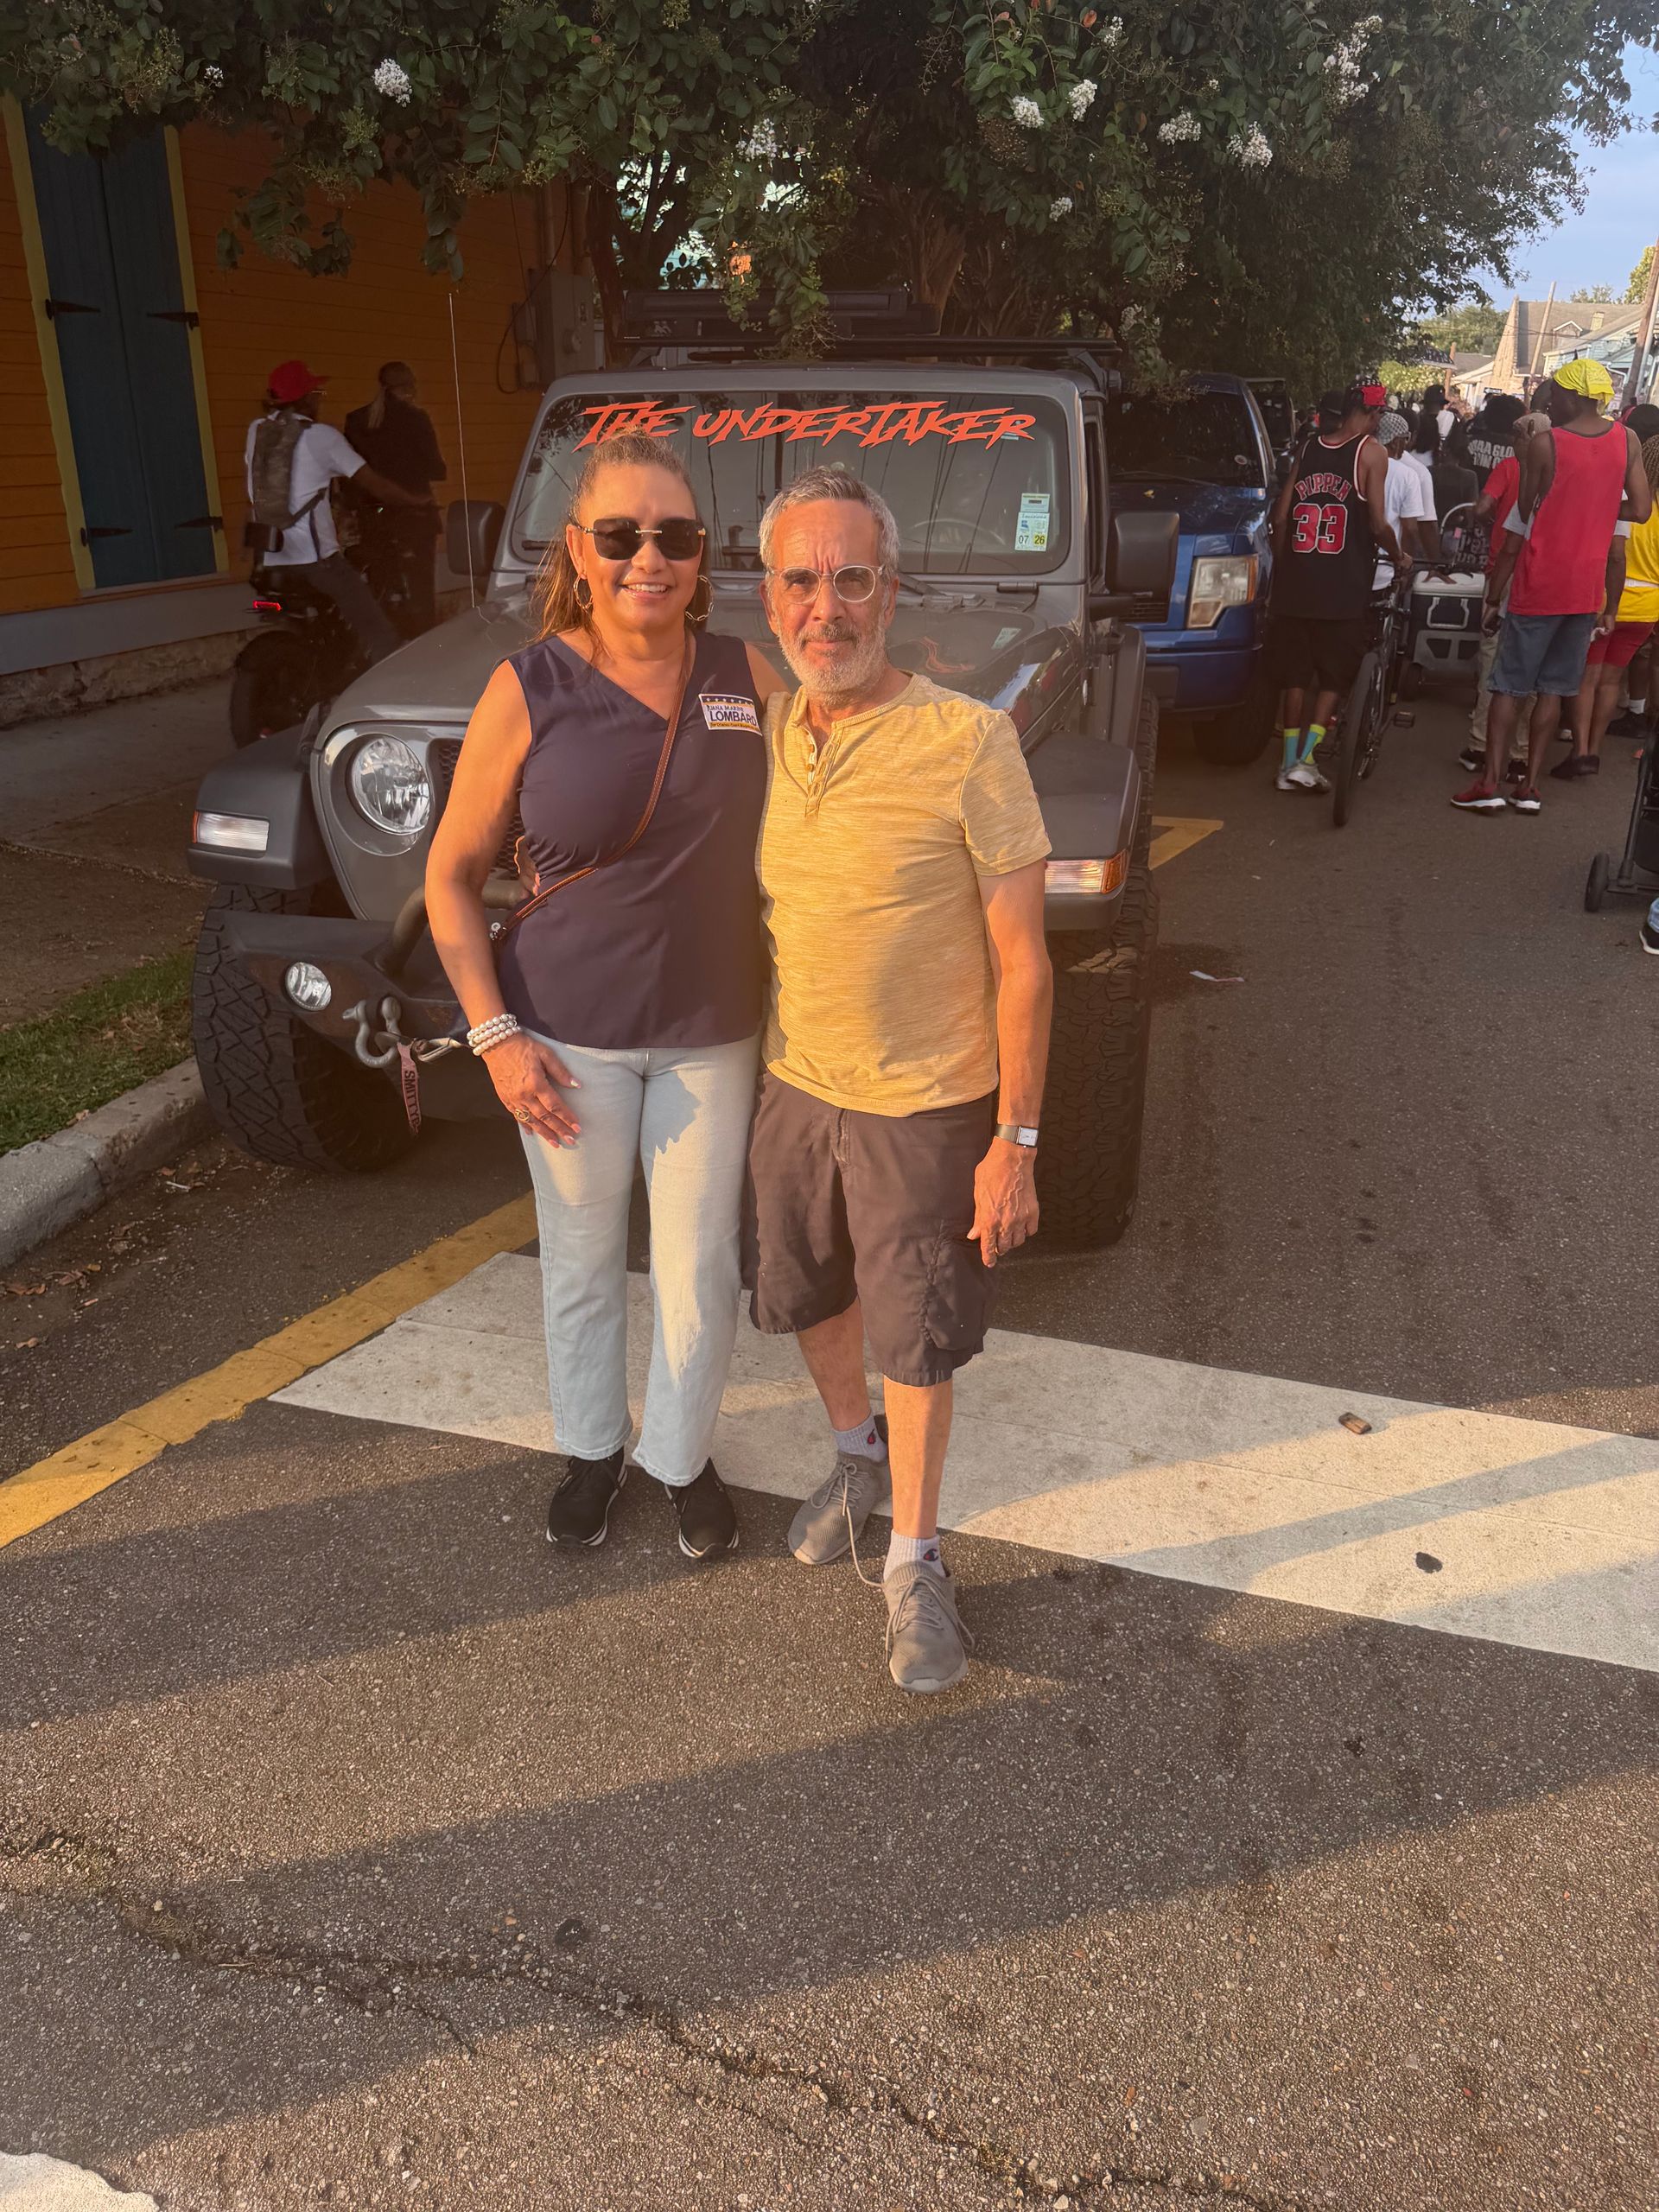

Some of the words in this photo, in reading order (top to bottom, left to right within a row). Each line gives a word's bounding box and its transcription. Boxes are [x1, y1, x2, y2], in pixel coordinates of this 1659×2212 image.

[572, 401, 696, 454] THE
[692, 401, 1037, 450] UNDERTAKER
[1294, 473, 1352, 502] PIPPEN
[1018, 535, 1029, 544] 07
[1034, 534, 1046, 545] 26
[1292, 502, 1348, 554] 33
[709, 711, 757, 726] LOMBARD
